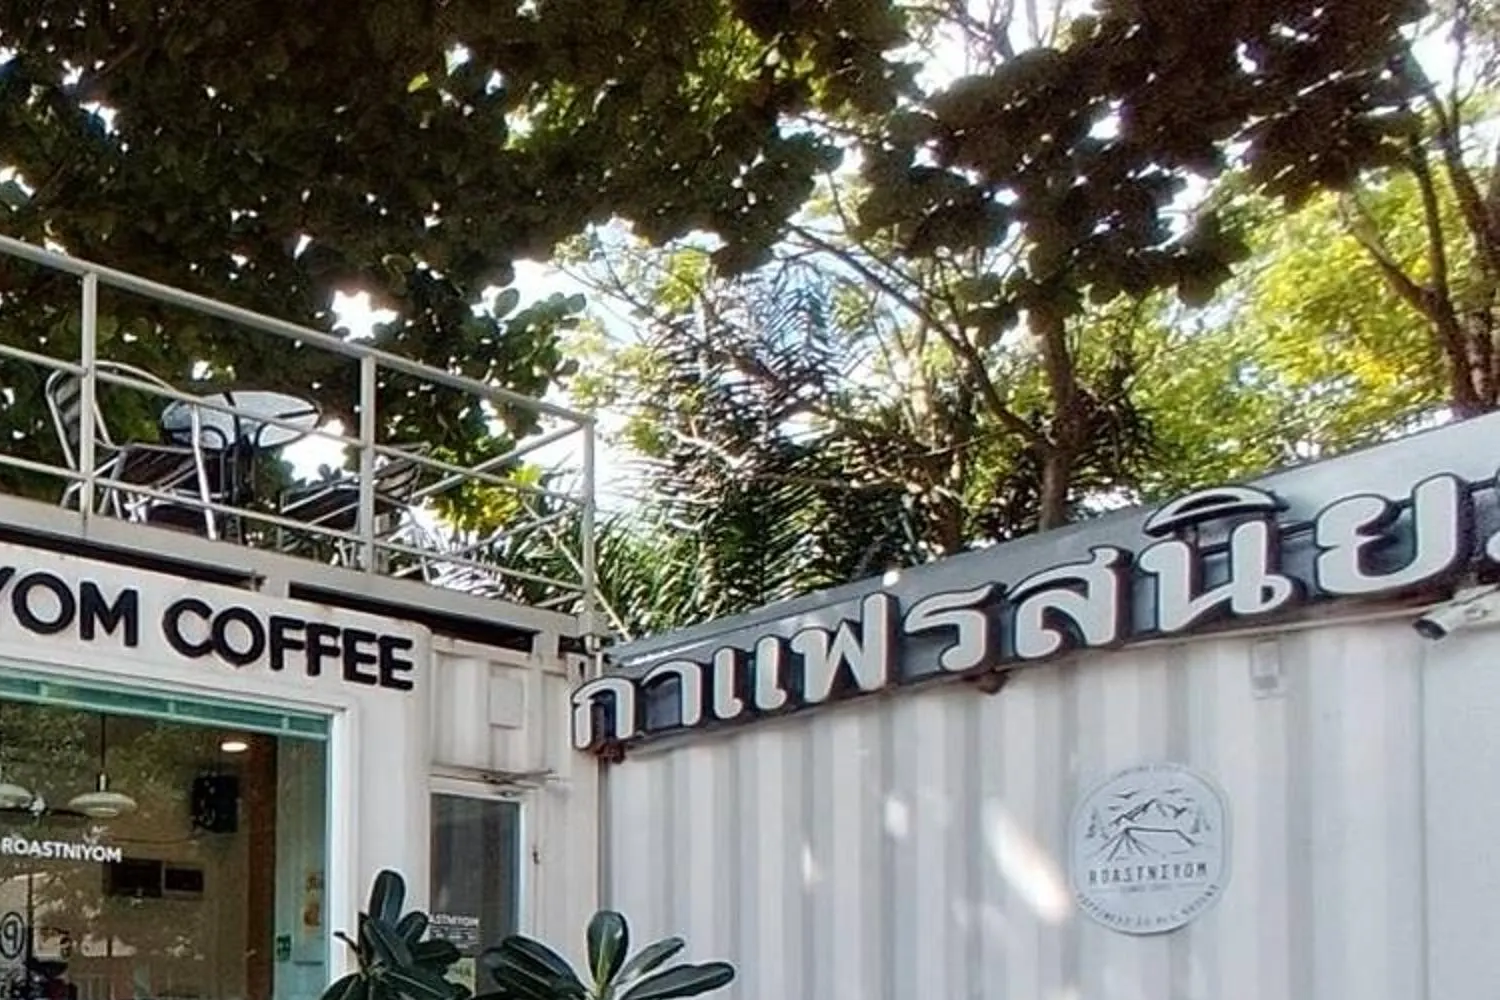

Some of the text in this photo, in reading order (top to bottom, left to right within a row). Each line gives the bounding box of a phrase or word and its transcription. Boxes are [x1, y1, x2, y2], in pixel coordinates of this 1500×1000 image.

[162, 597, 414, 690] COFFEE
[571, 472, 1500, 750] กาแฟรสนิย
[1, 837, 122, 863] ROASTNIYOM
